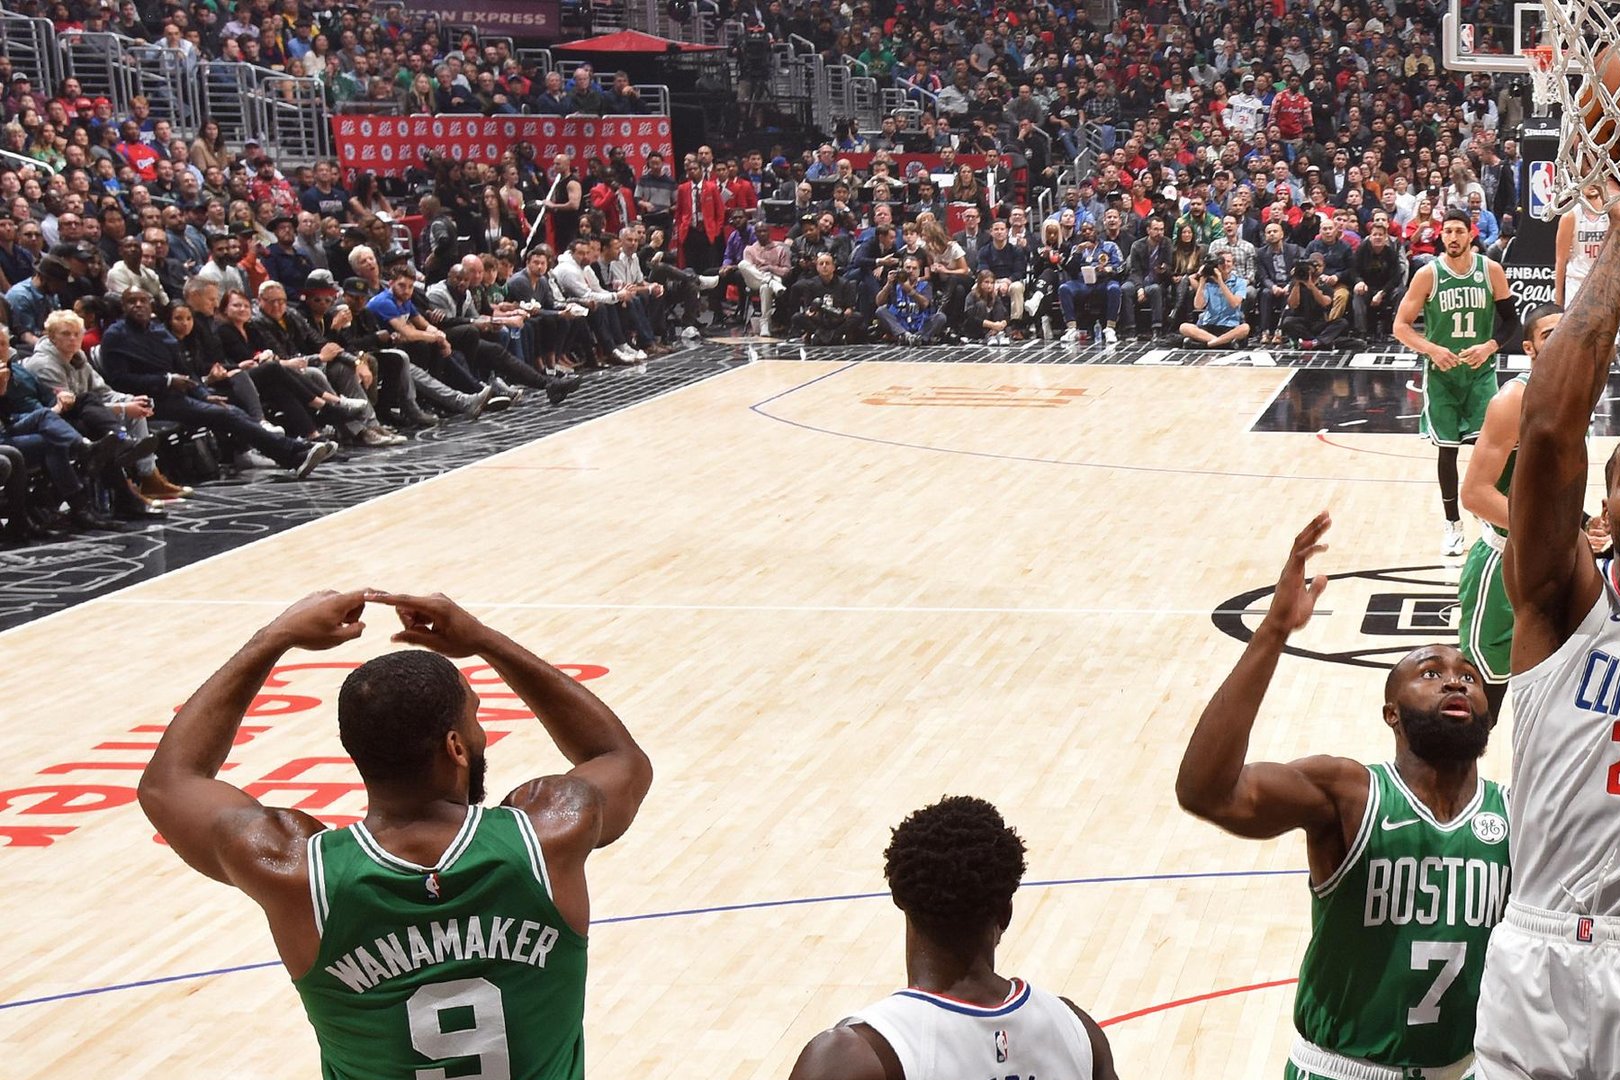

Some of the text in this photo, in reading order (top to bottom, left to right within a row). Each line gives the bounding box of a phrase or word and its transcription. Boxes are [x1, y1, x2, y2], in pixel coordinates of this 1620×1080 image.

[462, 11, 546, 25] EXPRESS
[1439, 286, 1487, 312] BOSTON
[1451, 311, 1477, 338] 11
[1363, 856, 1510, 928] BOSTON
[325, 916, 559, 994] WANAMAKER
[1407, 941, 1467, 1026] 7
